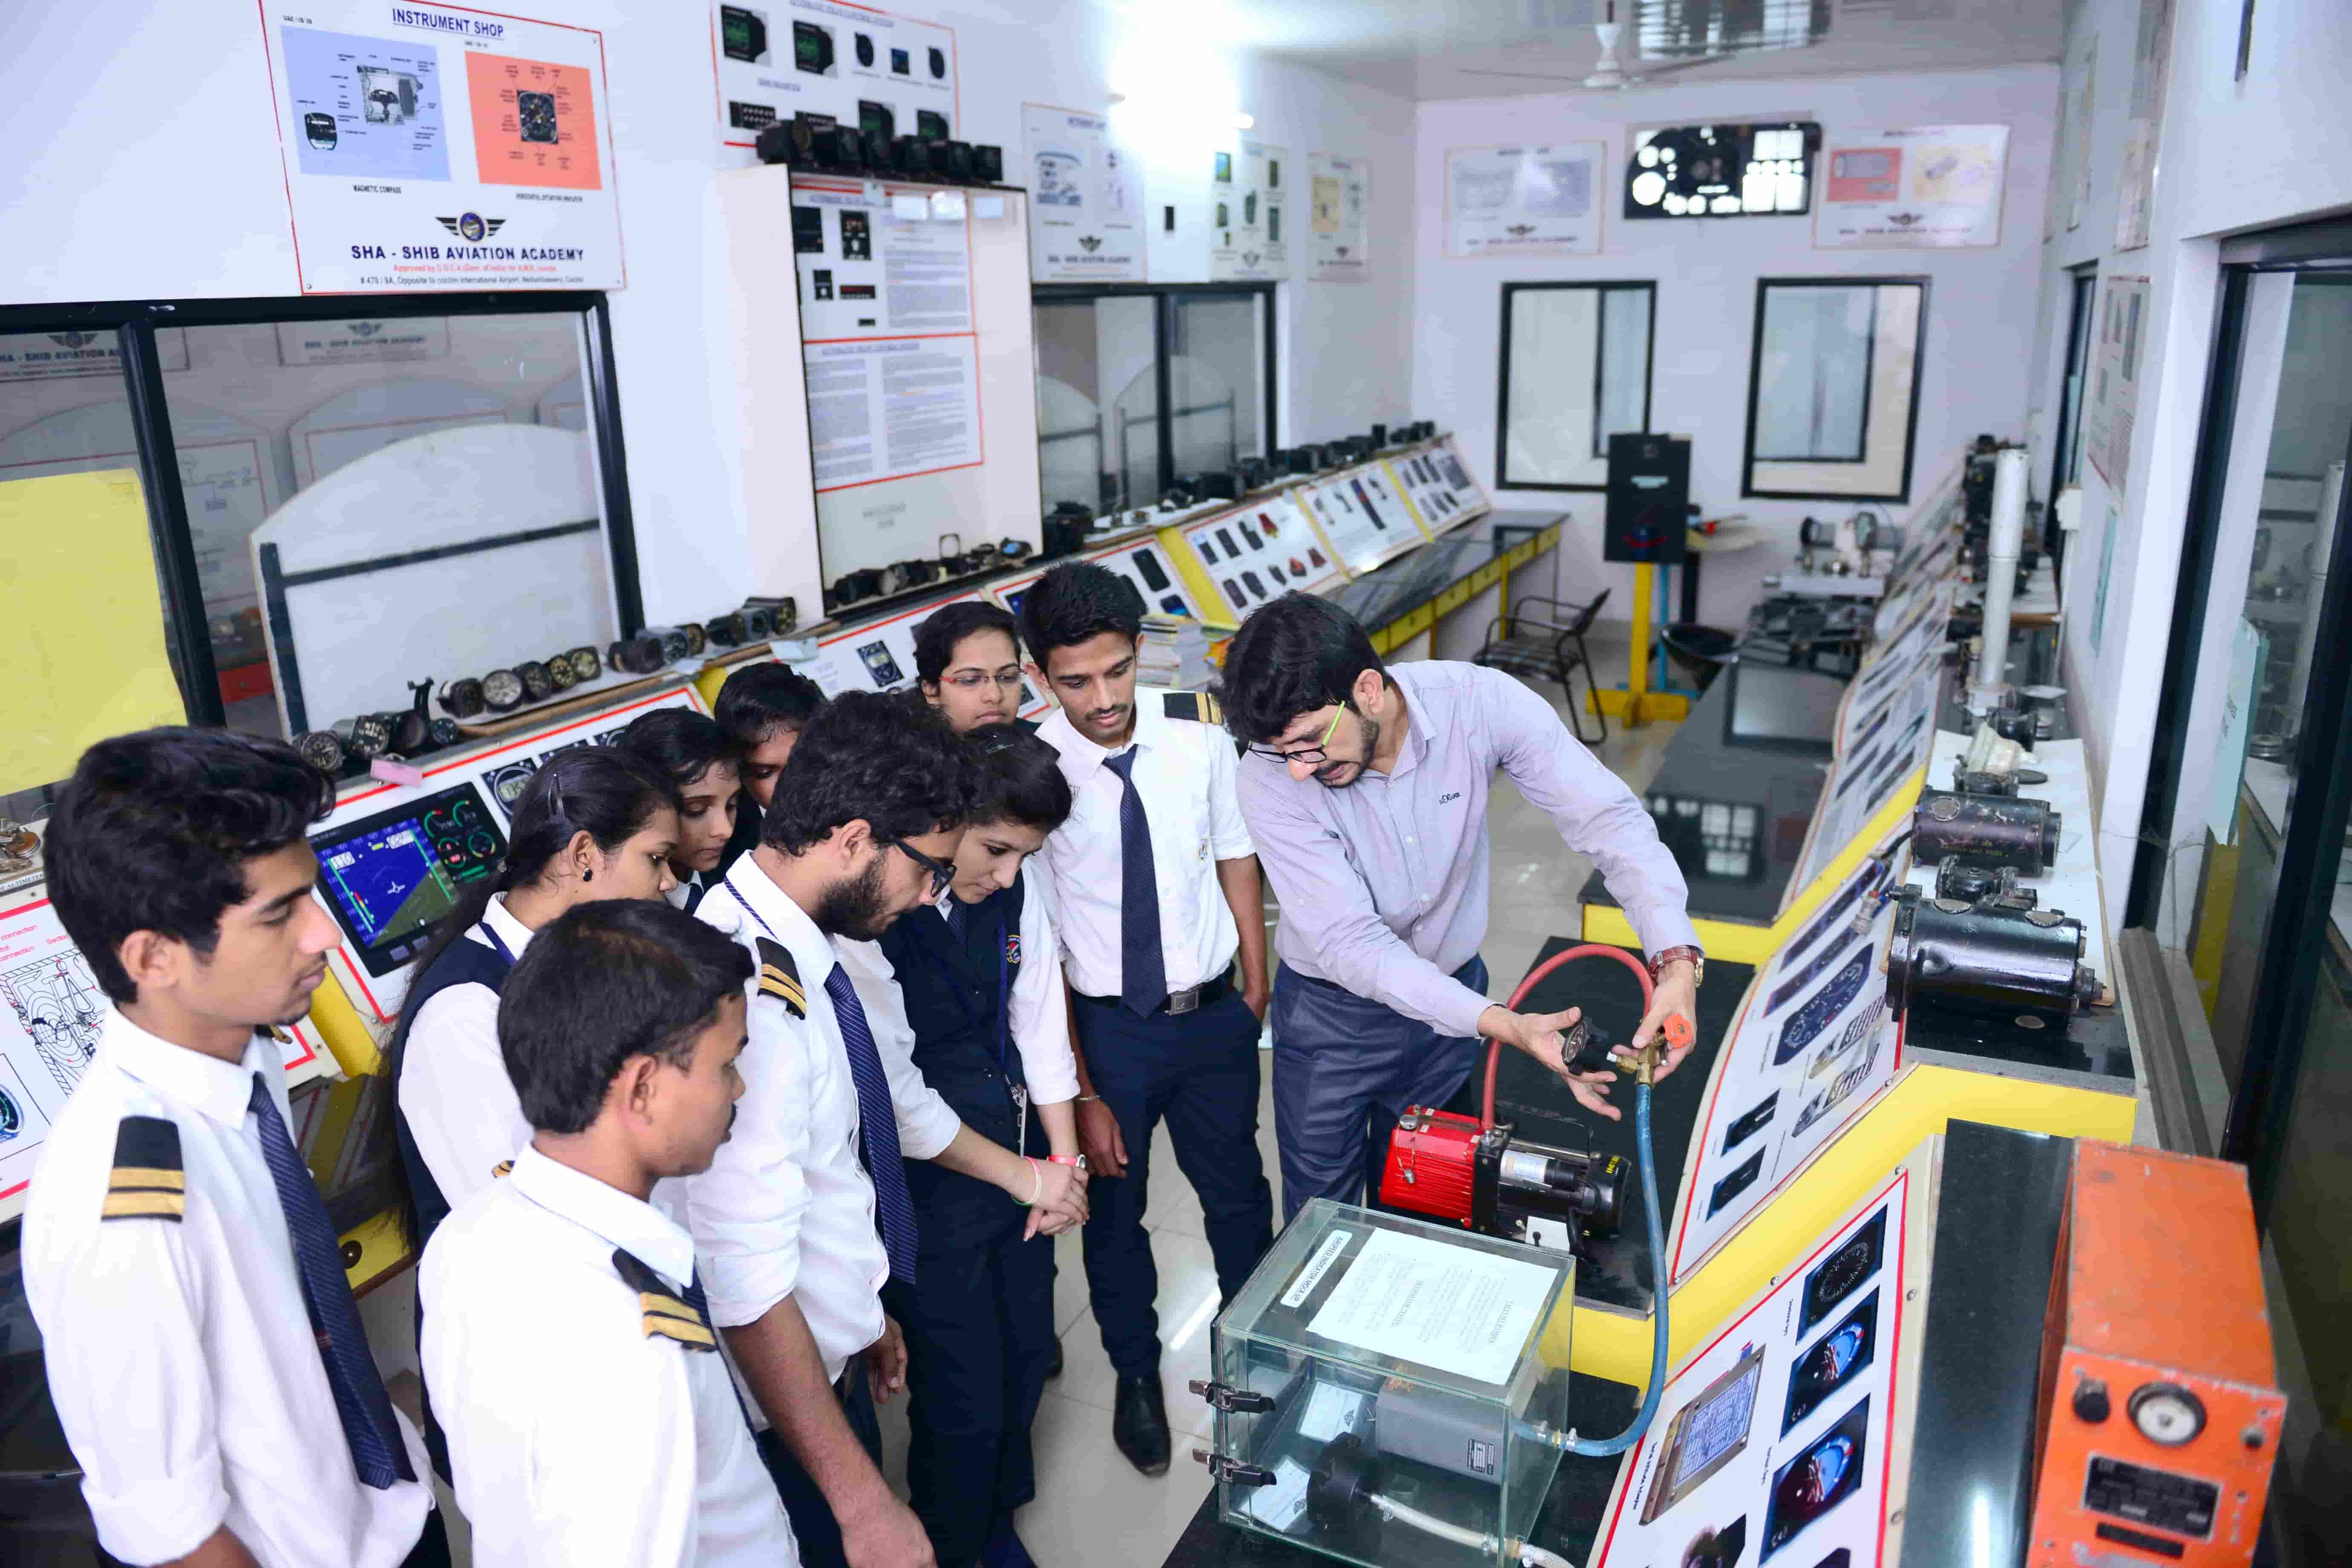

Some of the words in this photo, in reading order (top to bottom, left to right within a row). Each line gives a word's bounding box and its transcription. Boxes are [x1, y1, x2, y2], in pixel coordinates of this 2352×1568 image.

[392, 8, 470, 33] INSTRUMENT
[474, 22, 504, 37] SHOP
[352, 245, 386, 259] SHA
[402, 246, 439, 259] SHIB
[447, 247, 515, 259] AVIATION
[521, 248, 583, 261] ACADEMY
[1325, 1237, 1343, 1257] AIRSPEED
[1308, 1256, 1329, 1280] INDICATOR
[1294, 1279, 1312, 1302] MOCK-UP
